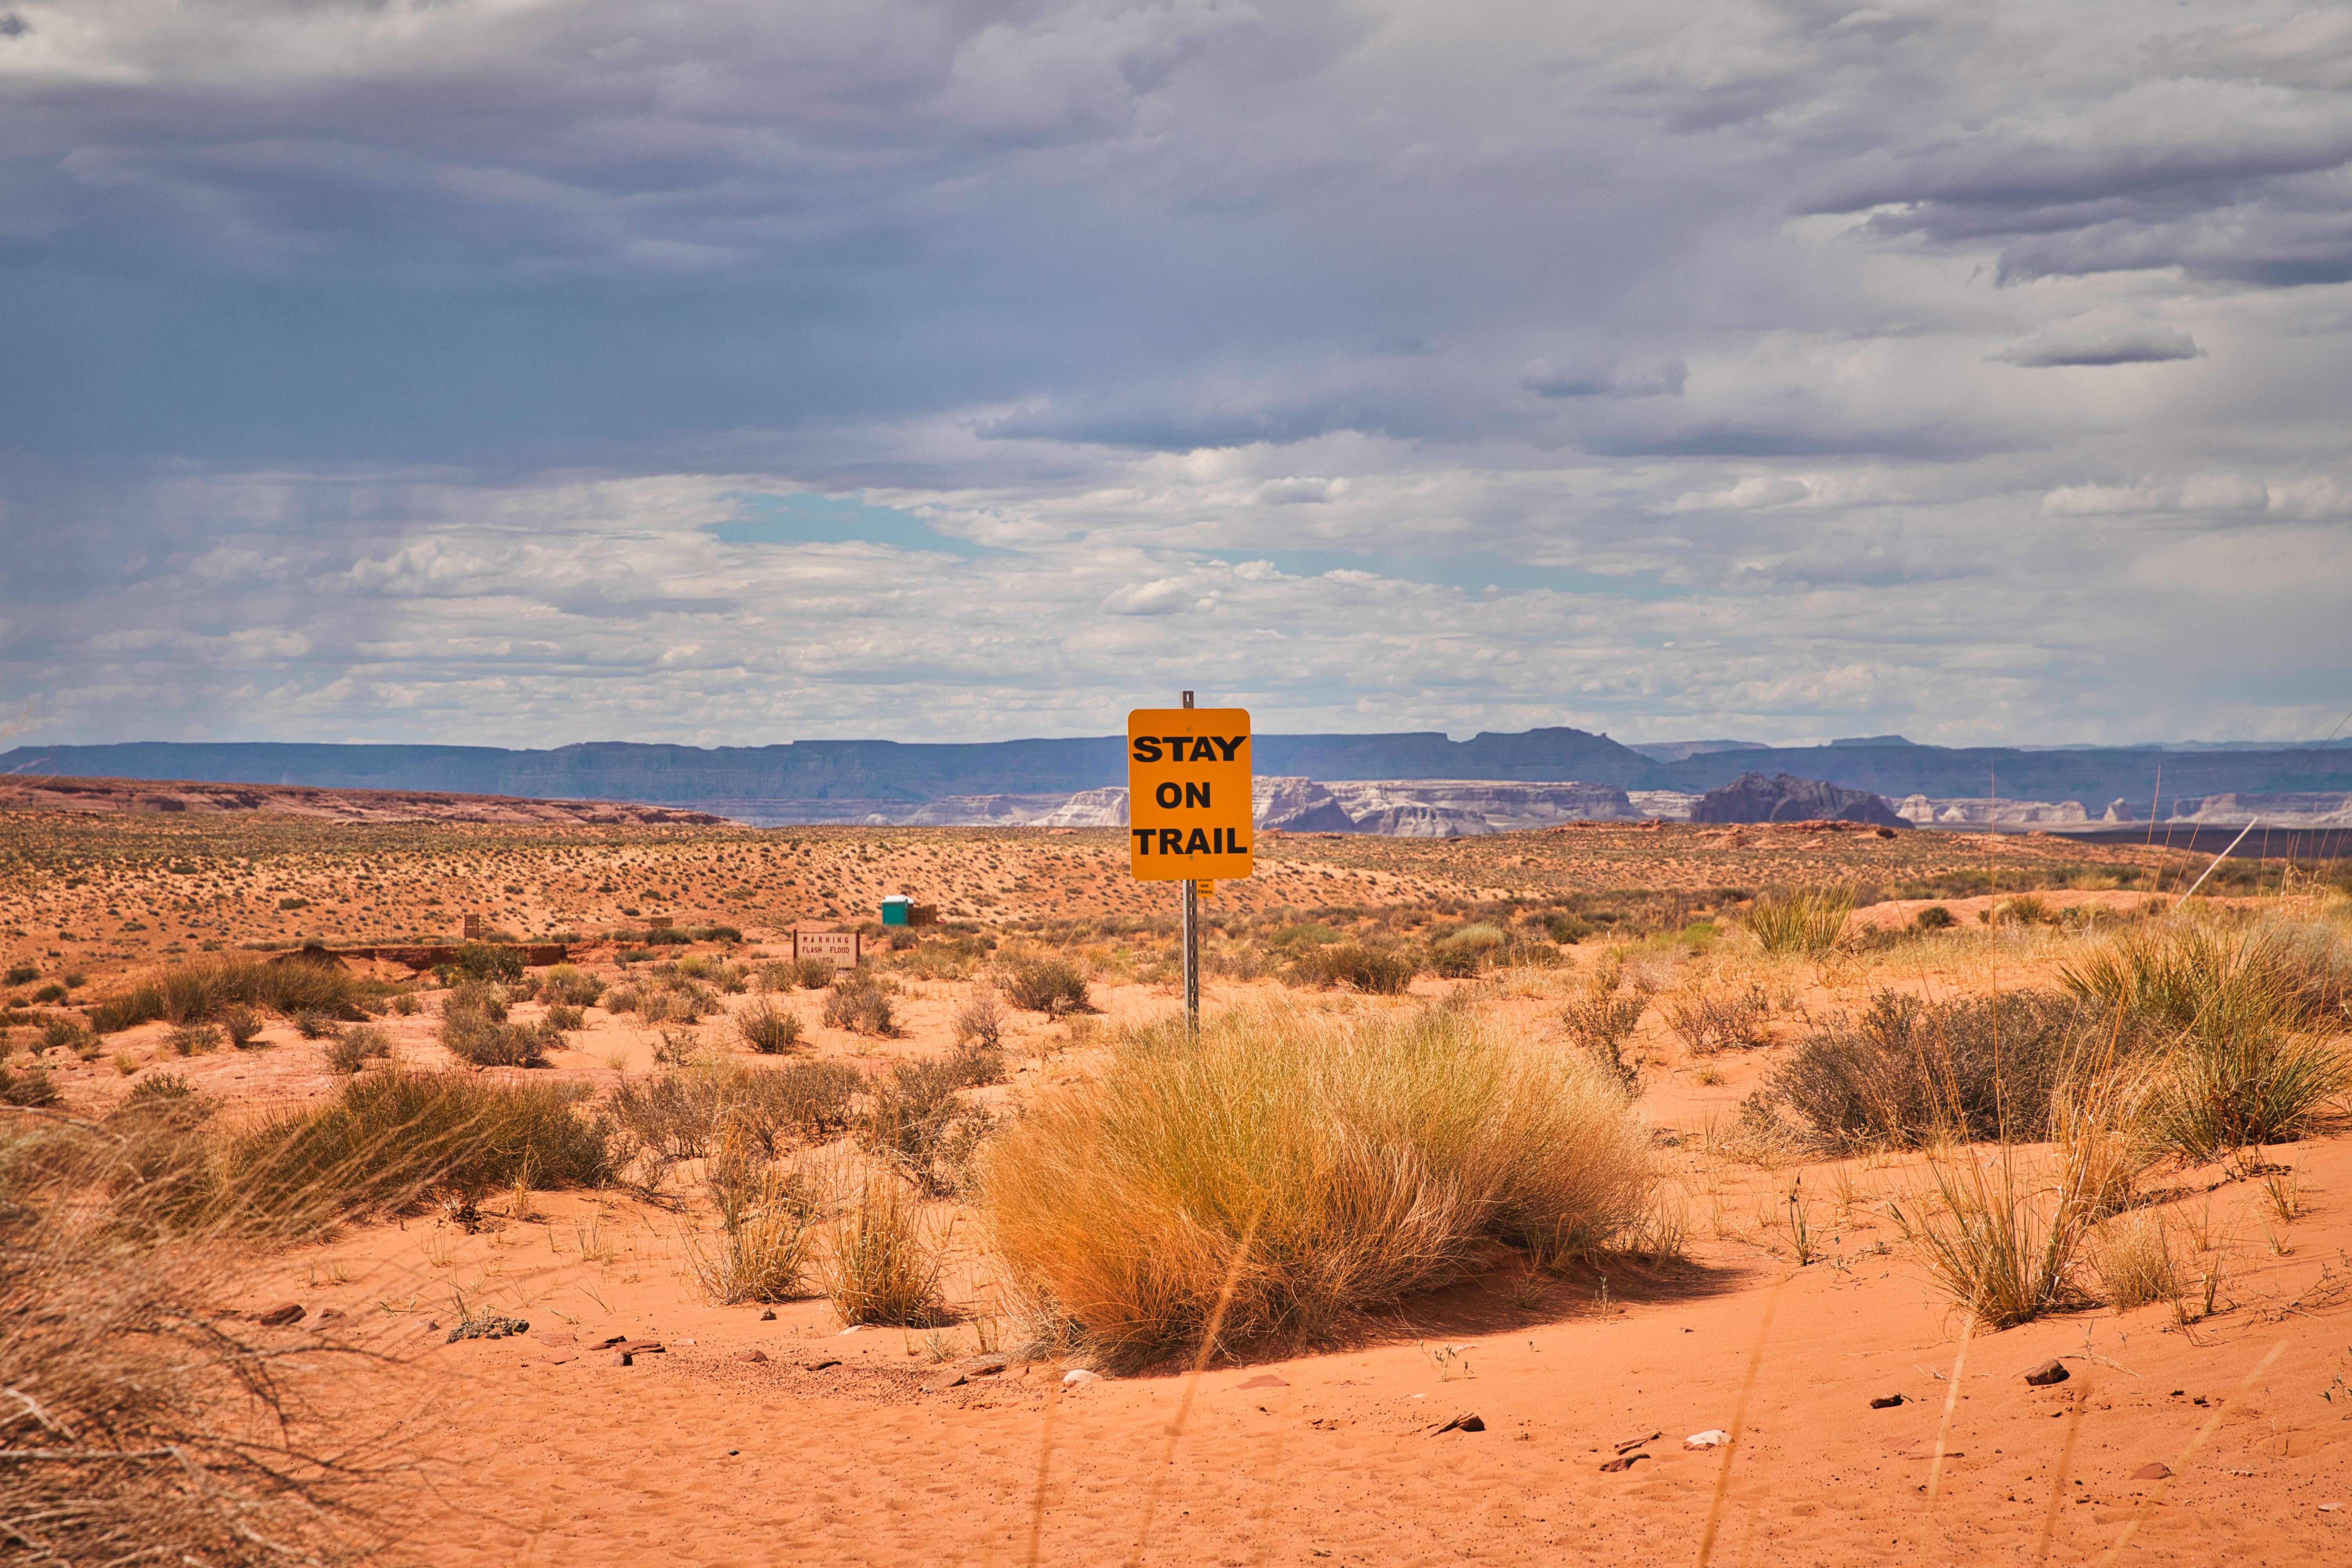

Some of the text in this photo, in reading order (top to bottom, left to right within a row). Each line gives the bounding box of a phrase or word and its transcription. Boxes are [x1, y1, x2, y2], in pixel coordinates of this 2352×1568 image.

[1133, 736, 1247, 762] STAY
[1156, 782, 1210, 809] ON
[1133, 828, 1247, 855] TRAIL
